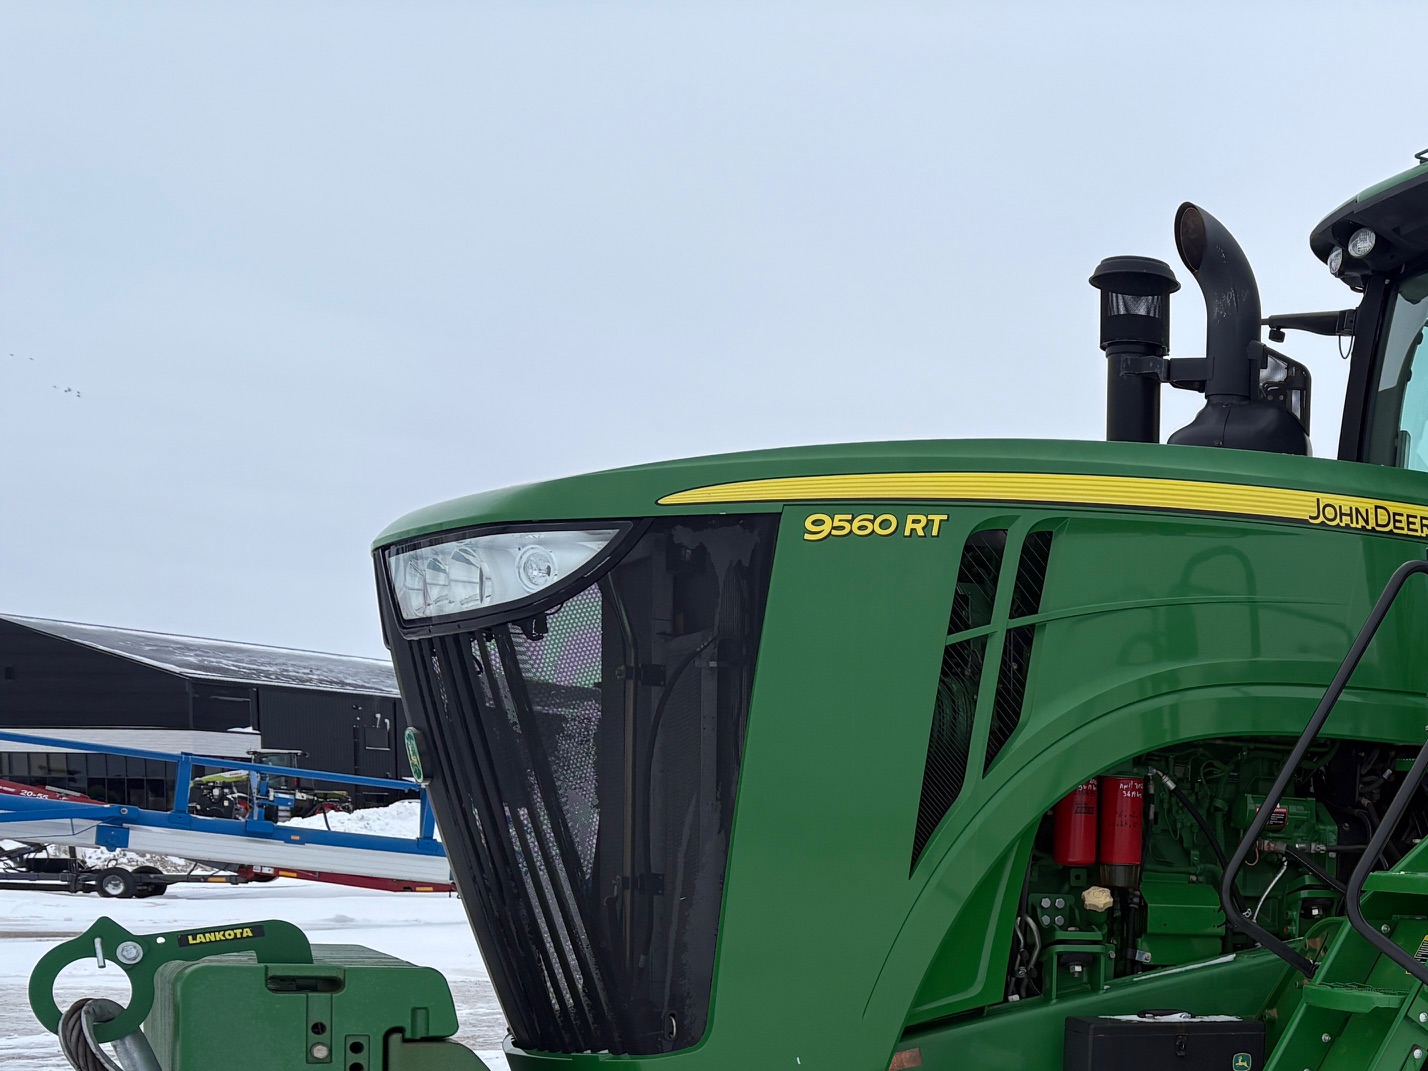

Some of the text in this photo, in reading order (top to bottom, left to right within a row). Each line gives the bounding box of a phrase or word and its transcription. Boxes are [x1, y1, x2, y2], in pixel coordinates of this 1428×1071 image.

[1308, 497, 1370, 527] JOHN
[803, 512, 949, 541] 9560 RT
[20, 789, 49, 800] 20-55
[187, 927, 254, 945] LANKOTA
